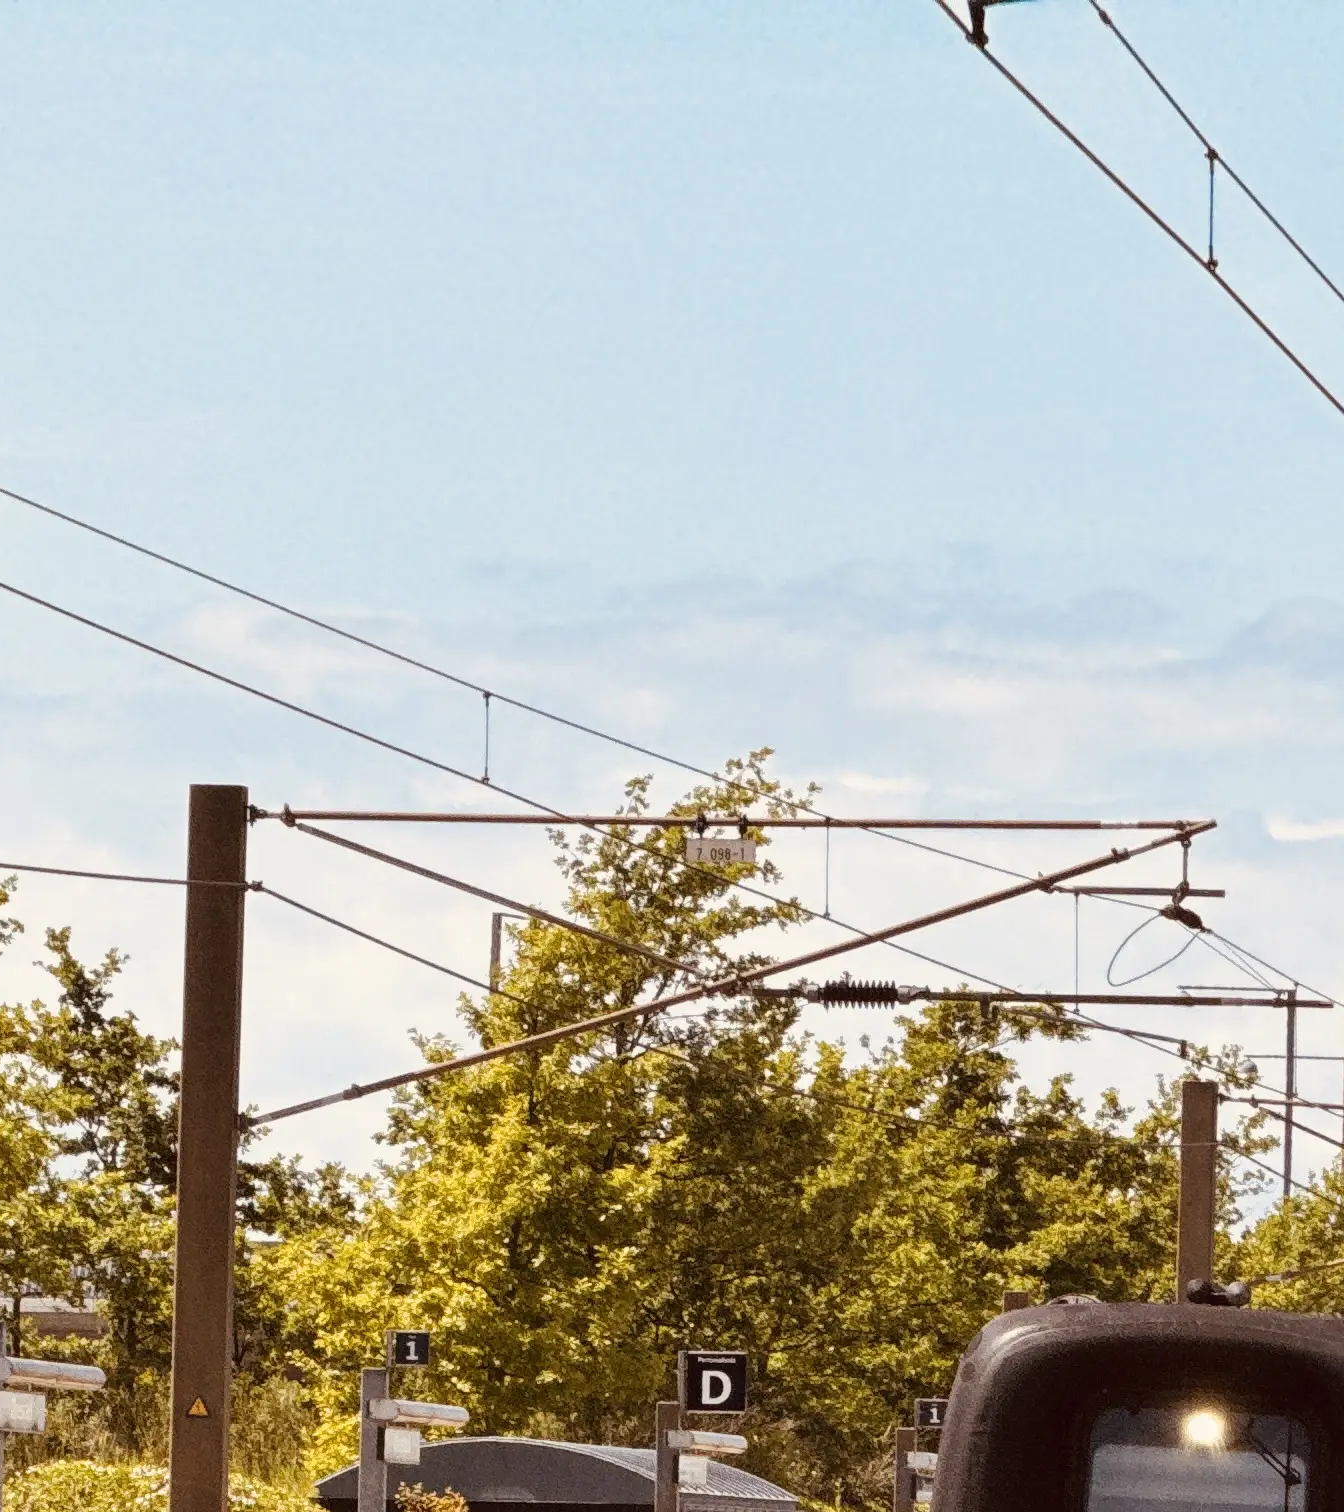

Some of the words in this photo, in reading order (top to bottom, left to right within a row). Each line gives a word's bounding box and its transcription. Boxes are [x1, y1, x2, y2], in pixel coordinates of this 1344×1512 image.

[406, 1340, 418, 1360] 1
[701, 1370, 732, 1405] D
[930, 1407, 941, 1423] 1
